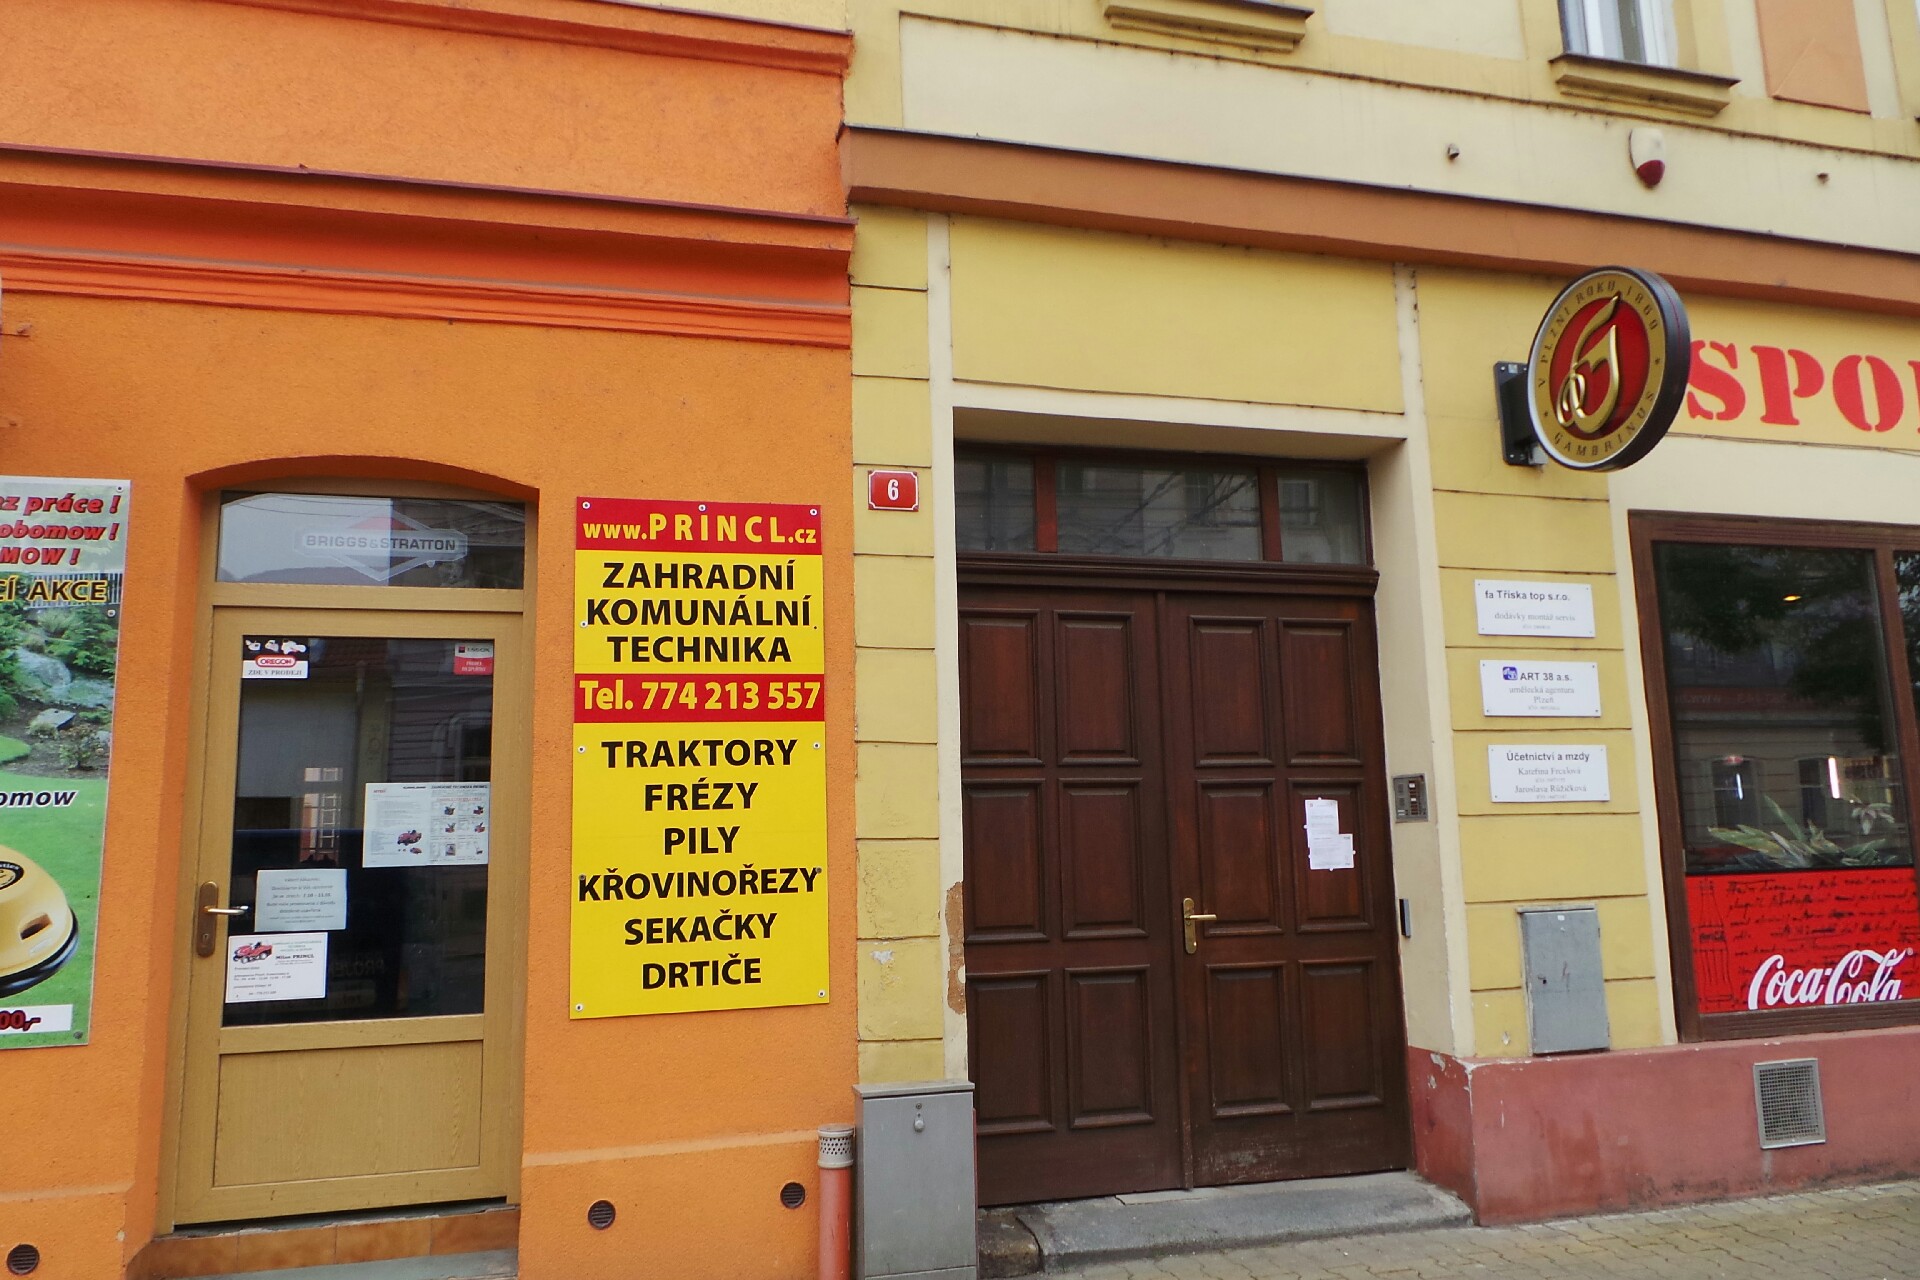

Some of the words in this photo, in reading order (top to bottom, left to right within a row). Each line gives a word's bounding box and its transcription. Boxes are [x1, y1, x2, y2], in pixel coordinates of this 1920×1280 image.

[1576, 280, 1616, 303] ROKU
[1687, 340, 1920, 433] SPO
[1554, 391, 1654, 456] GAMBRINUS
[23, 493, 104, 516] práce
[887, 479, 899, 501] 6
[583, 513, 816, 544] www.PRINCL.cz
[602, 559, 796, 590] ZAHRADNÍ
[28, 579, 108, 602] AKCE
[1485, 590, 1494, 599] fa
[1529, 592, 1545, 602] top
[1547, 593, 1571, 601] s.r.o.
[587, 594, 812, 626] KOMUNÁLNÍ
[606, 636, 792, 663] TECHNIKA
[1519, 672, 1540, 681] ART
[1543, 672, 1554, 681] 38
[579, 679, 634, 710] Tel.
[641, 681, 698, 710] 774
[704, 681, 760, 710] 213
[767, 681, 821, 710] 557
[600, 739, 798, 768] TRAKTORY
[1506, 750, 1555, 761] Účetnictví
[1565, 752, 1590, 762] mzdy
[644, 777, 759, 812] FRÉZY
[664, 826, 740, 855] PILY
[579, 863, 819, 902] KŘOVINOŘEZY
[624, 908, 777, 945] SEKAČKY
[642, 953, 761, 990] DRTIČE
[1747, 949, 1908, 1010] Coca-Cola
